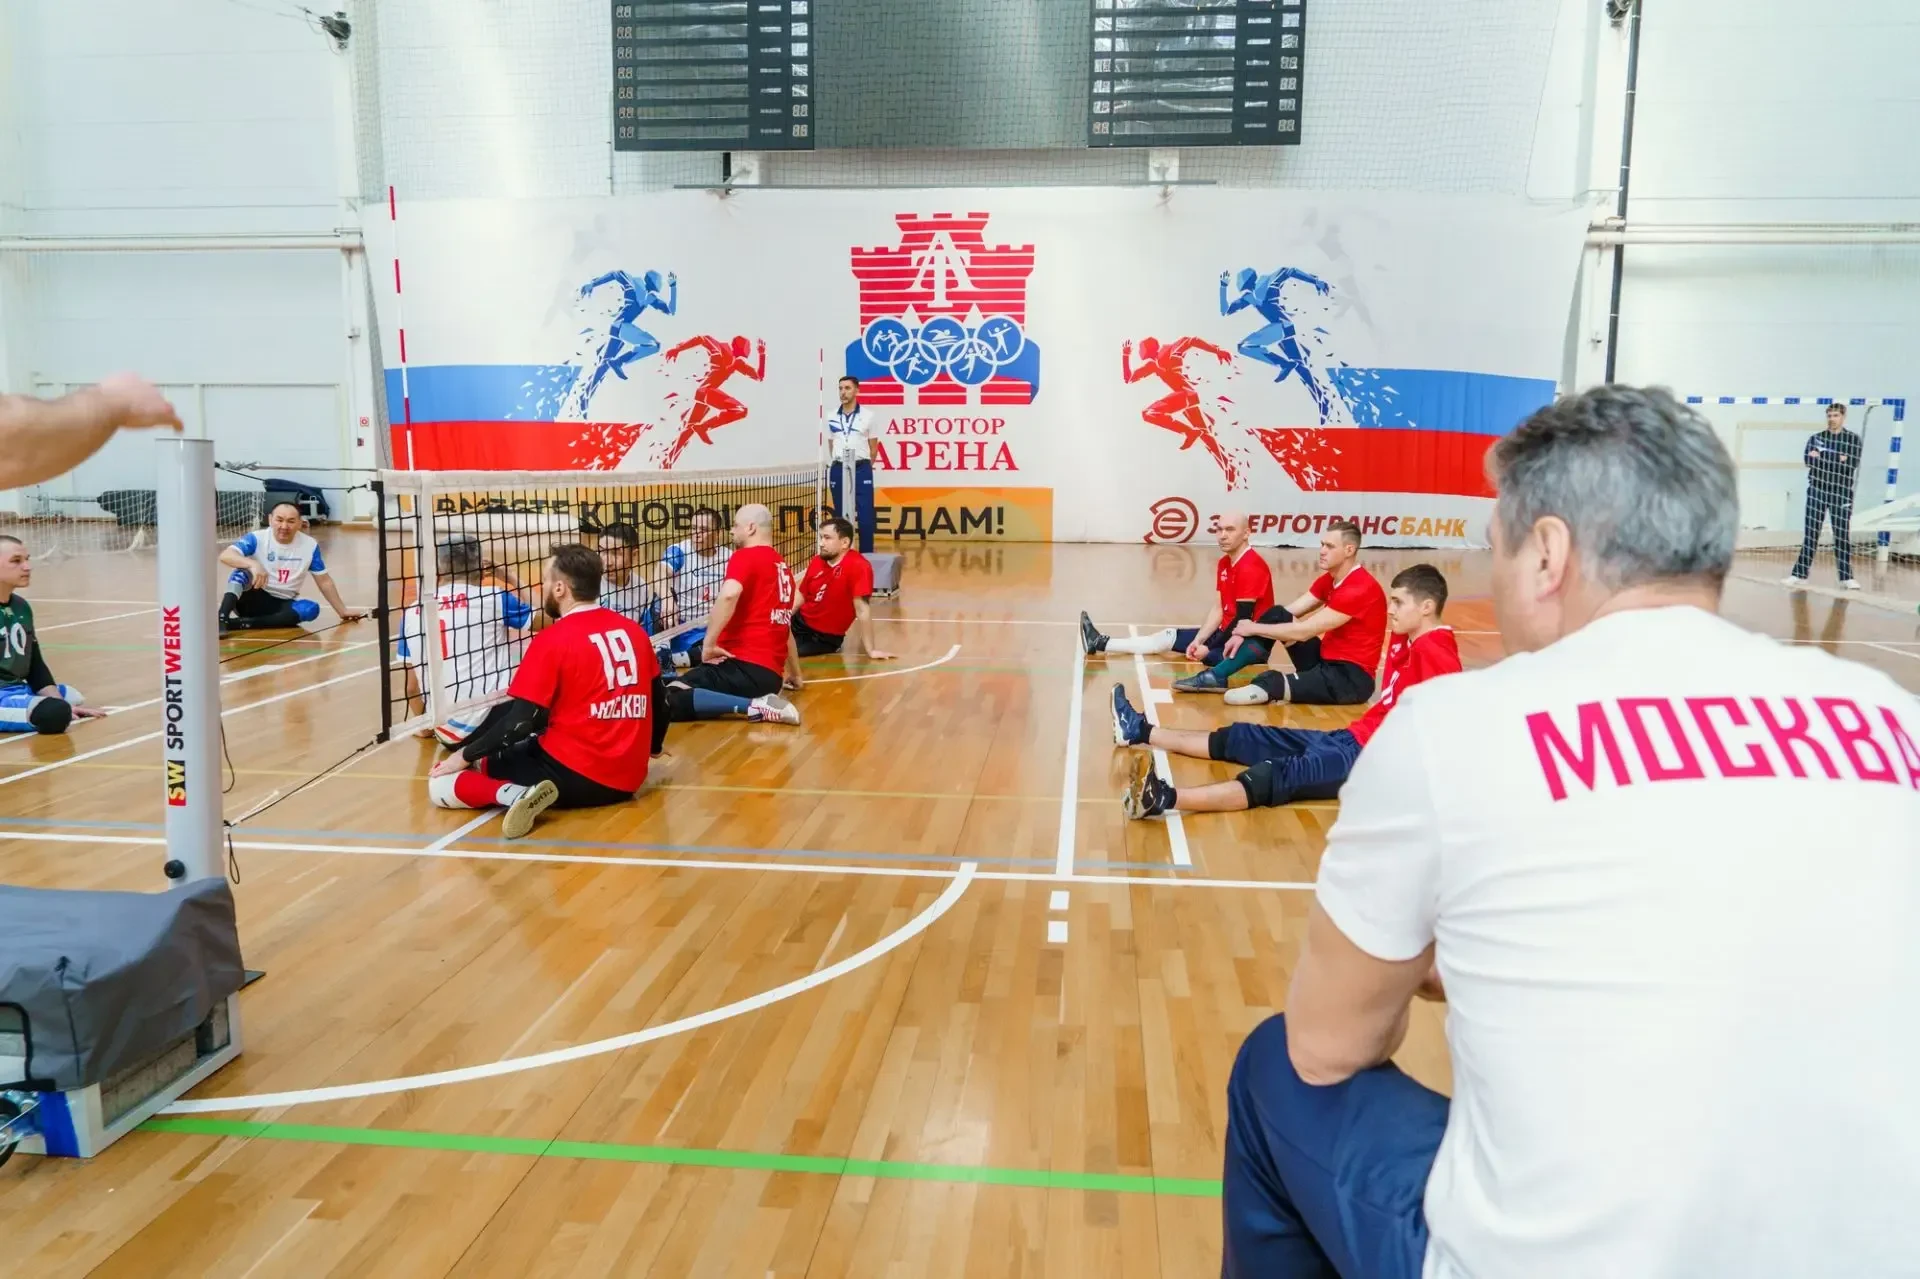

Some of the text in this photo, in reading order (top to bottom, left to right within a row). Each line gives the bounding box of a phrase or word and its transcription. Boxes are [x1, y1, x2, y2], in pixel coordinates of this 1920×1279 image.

[886, 418, 1005, 435] АВТОТОР
[872, 440, 1019, 471] АРЕНА
[780, 505, 1004, 540] ПОЕДАМ!
[1207, 513, 1467, 537] ЭЕРГОТРАНСБАНК
[278, 569, 290, 583] 17
[588, 628, 638, 691] 19
[163, 605, 185, 750] SPORTWERK
[590, 694, 647, 720] МОСКВА
